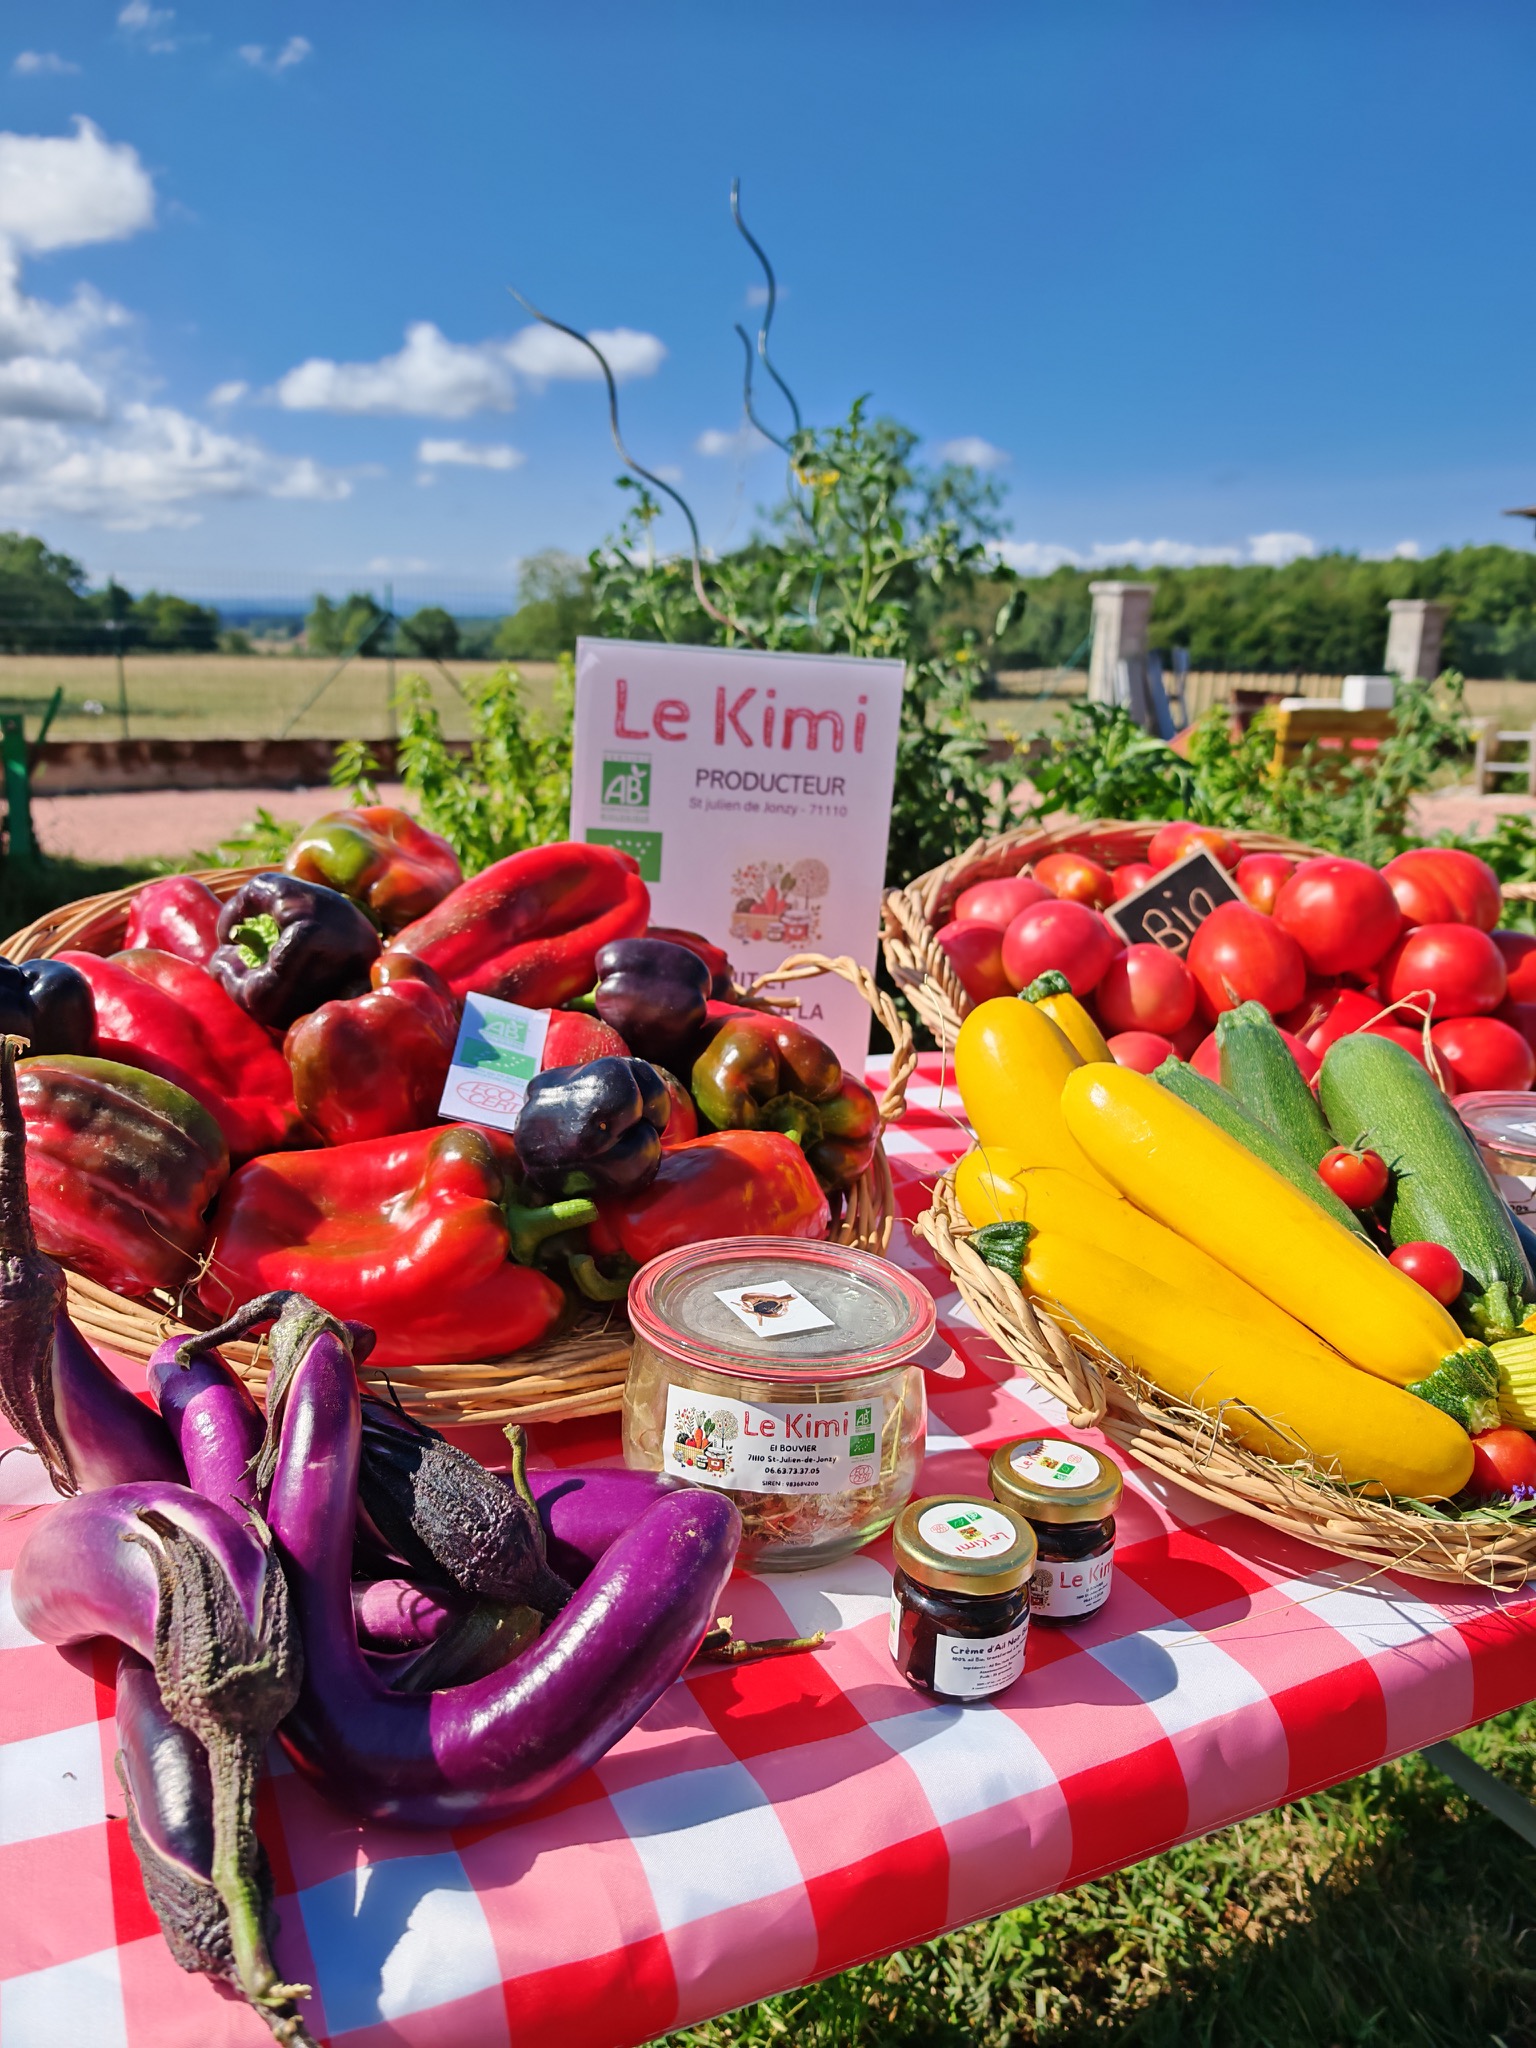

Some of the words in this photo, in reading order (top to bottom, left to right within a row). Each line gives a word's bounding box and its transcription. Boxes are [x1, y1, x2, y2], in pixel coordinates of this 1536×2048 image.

[613, 678, 690, 742] Le
[713, 685, 869, 754] Kimi
[604, 774, 644, 805] AB
[695, 768, 846, 797] PRODUCTEUR
[688, 797, 703, 810] St
[743, 801, 760, 812] de
[763, 801, 798, 817] Jonzy
[809, 803, 848, 818] 71110
[1141, 886, 1217, 953] Bio
[798, 1003, 824, 1020] LA
[470, 1082, 516, 1102] ECO
[468, 1093, 523, 1112] CERT
[743, 1410, 776, 1438] Le
[785, 1411, 849, 1438] Kimi
[779, 1444, 817, 1452] BOUVIER
[748, 1453, 765, 1462] 71110
[1015, 1460, 1034, 1470] Le
[764, 1466, 820, 1475] 06.63.73.37.05
[989, 1531, 1011, 1541] Le
[955, 1537, 993, 1554] Kimi
[1060, 1571, 1084, 1588] Le
[950, 1645, 985, 1655] Crème
